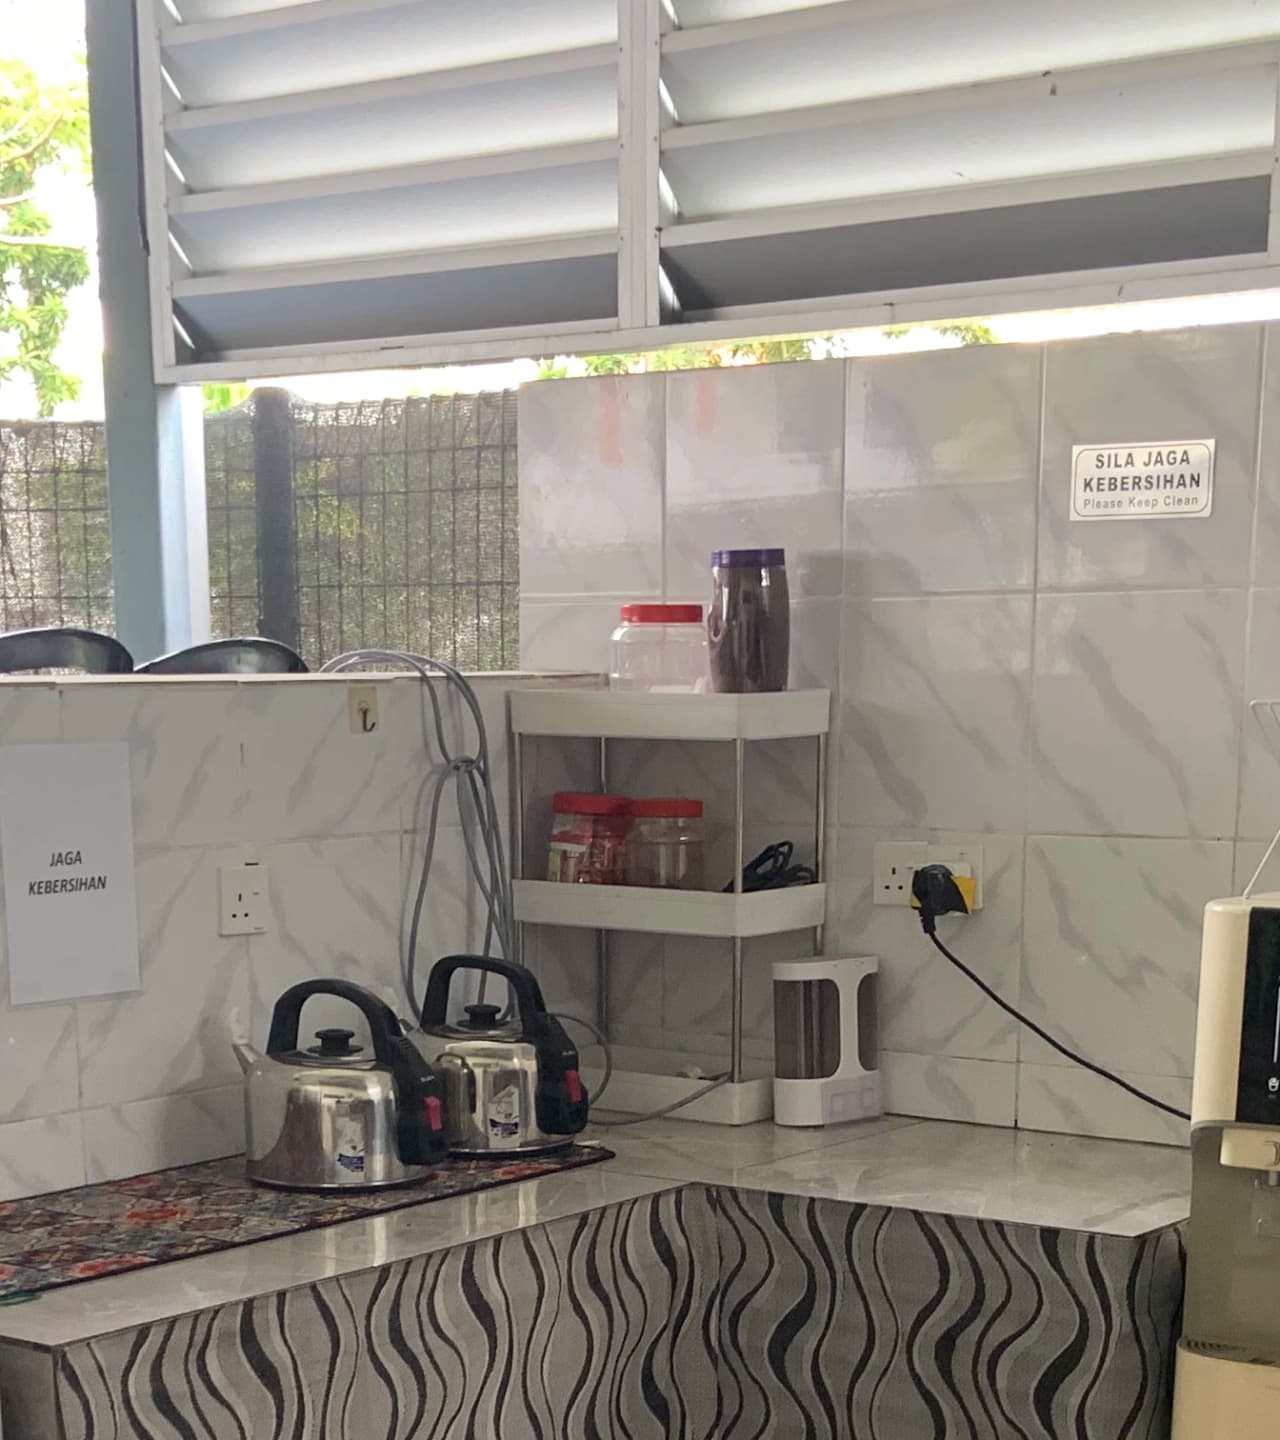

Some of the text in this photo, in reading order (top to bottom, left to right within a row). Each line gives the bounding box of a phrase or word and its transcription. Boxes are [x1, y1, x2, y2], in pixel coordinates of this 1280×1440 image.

[1095, 450, 1190, 470] SILA JAGA
[1083, 473, 1201, 493] KEBERSIHAN
[1083, 495, 1198, 509] Please Keep Clean
[50, 850, 82, 867] JAGA
[28, 875, 107, 896] KEBERSIHAN
